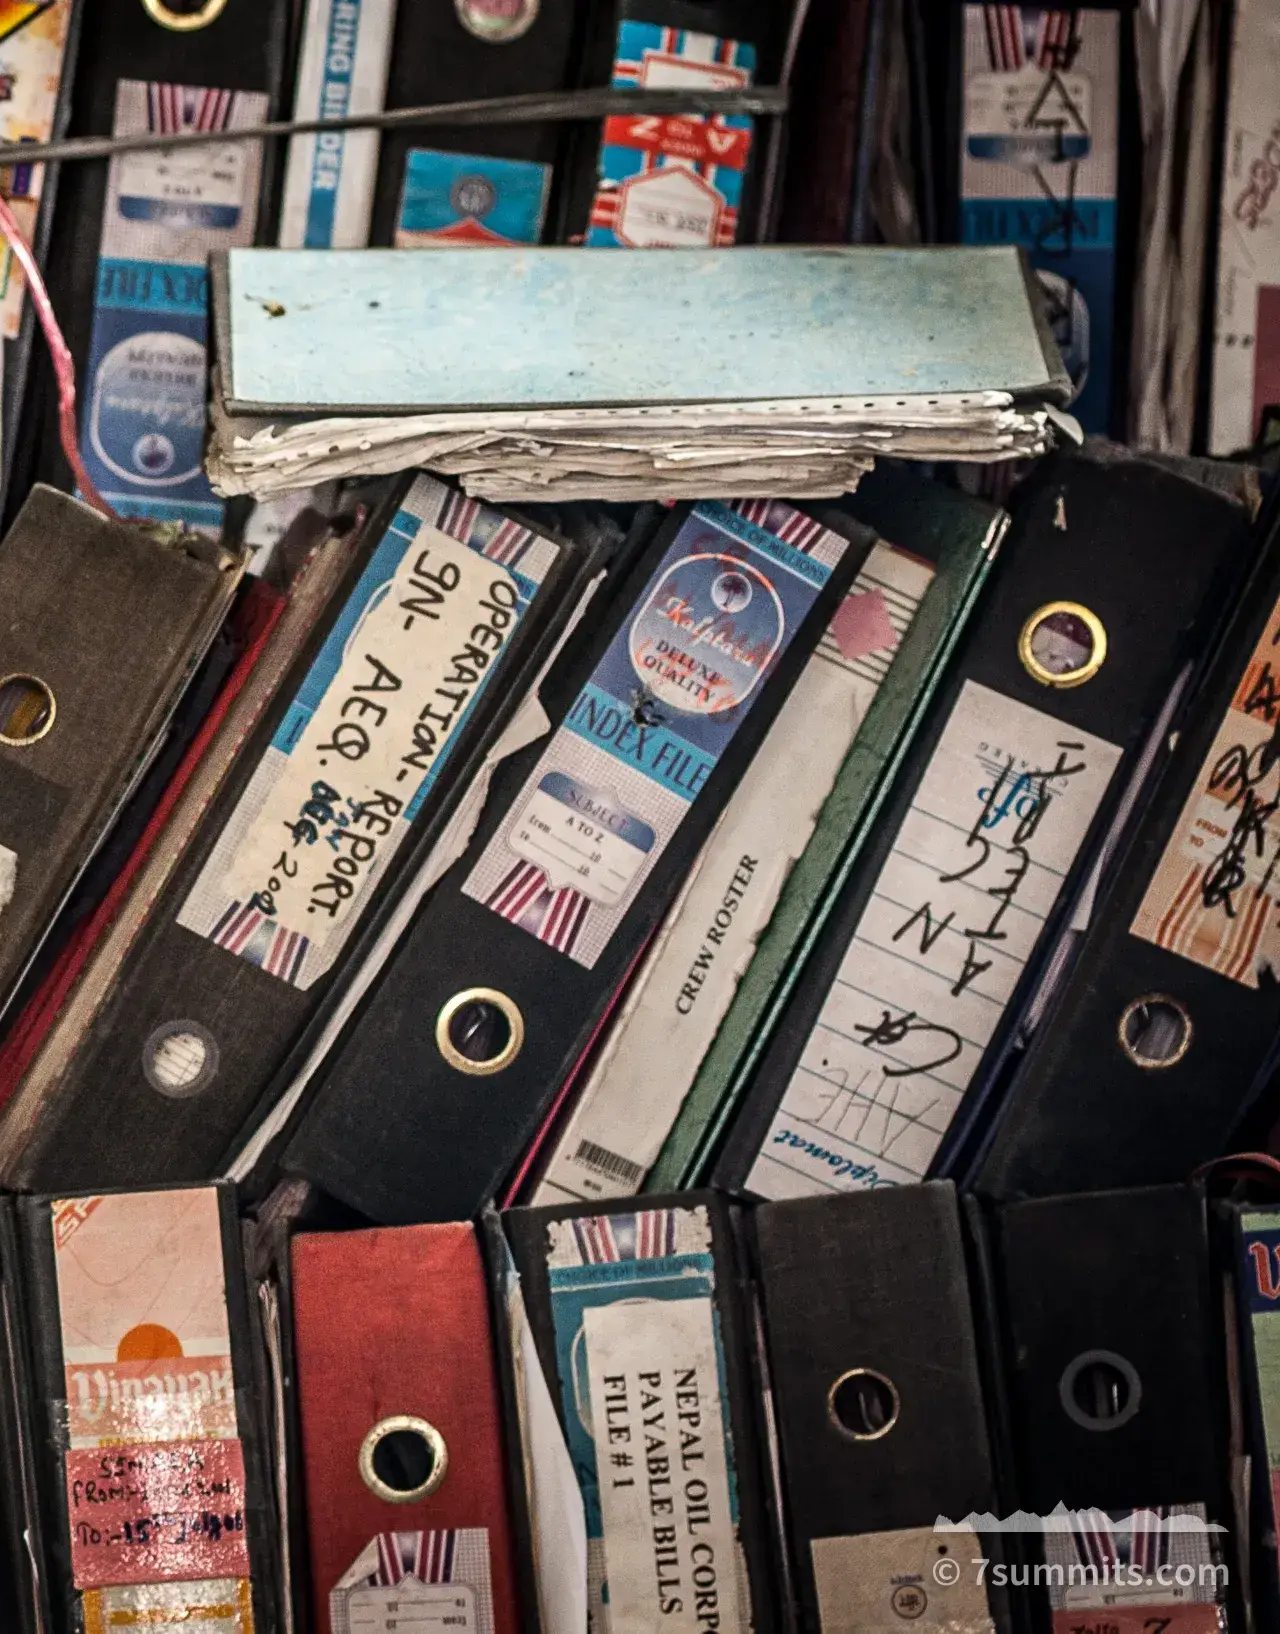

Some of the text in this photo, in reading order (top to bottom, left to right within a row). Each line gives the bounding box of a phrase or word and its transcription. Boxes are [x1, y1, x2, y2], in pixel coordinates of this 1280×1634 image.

[642, 653, 716, 703] QUALITY
[655, 637, 723, 686] DELUXE
[568, 692, 712, 797] INDEX FILE
[673, 852, 759, 1019] CREW ROSTER
[603, 1374, 635, 1489] FILE # 1
[638, 1370, 683, 1616] PAYABLE BILLS
[673, 1367, 720, 1634] NEPAL OIL CORP
